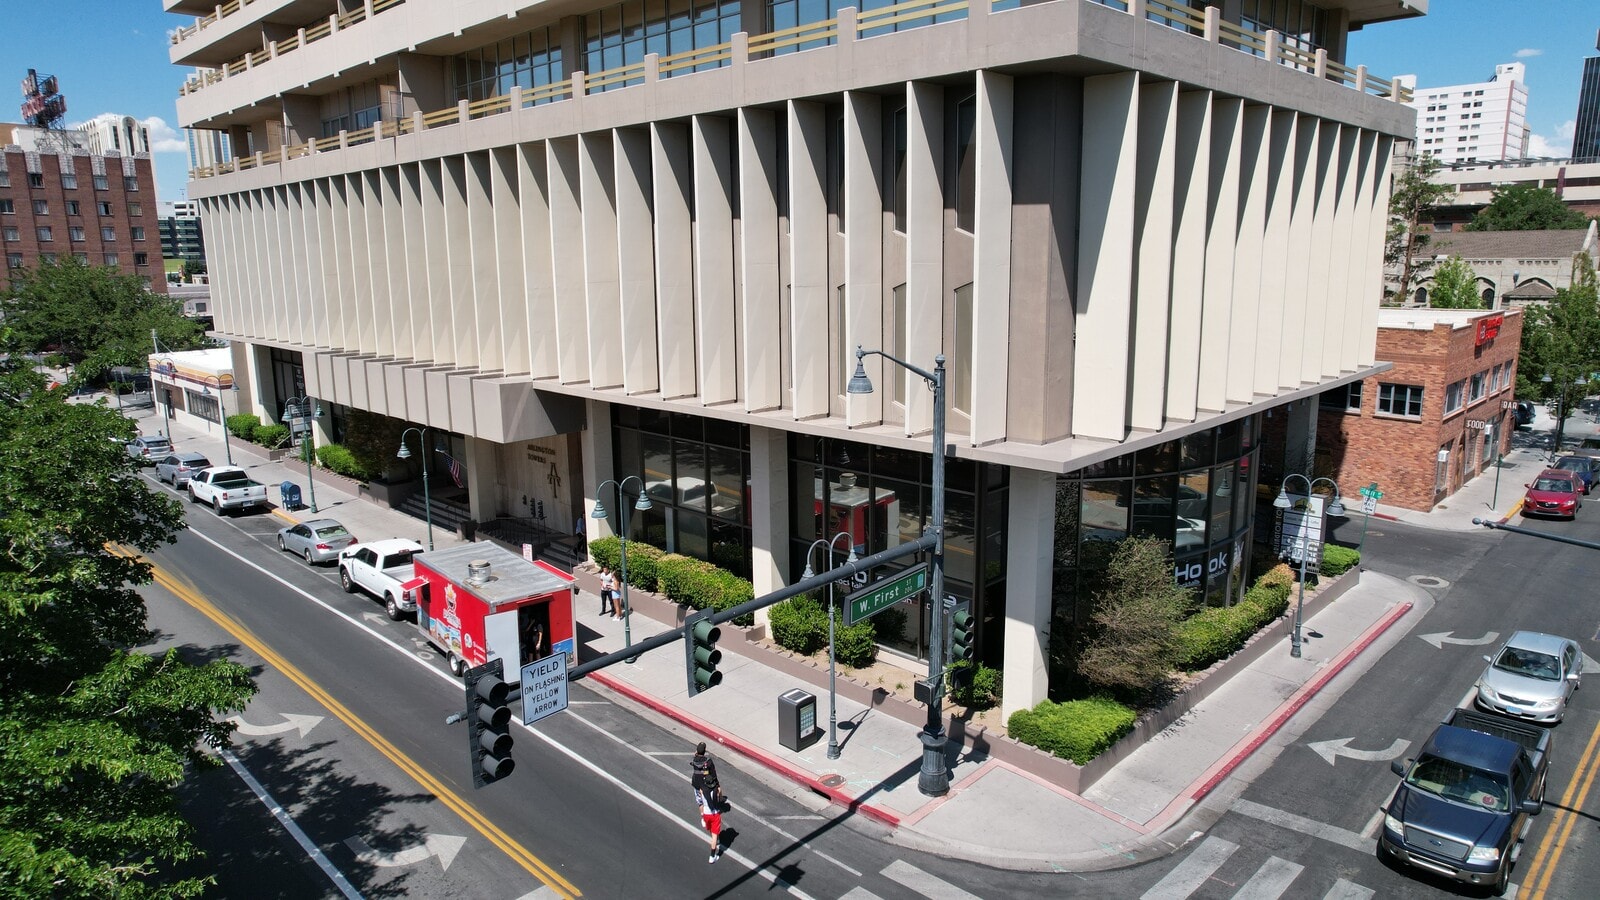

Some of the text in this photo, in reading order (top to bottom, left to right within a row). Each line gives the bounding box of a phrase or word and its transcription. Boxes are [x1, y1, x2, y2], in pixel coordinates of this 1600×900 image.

[1502, 401, 1517, 409] BAR
[1466, 420, 1485, 429] FOOD
[859, 600, 871, 614] W.
[874, 586, 900, 607] First
[529, 661, 559, 679] YIELD
[524, 673, 565, 695] ON FLASHING
[532, 686, 560, 704] YELLOW
[534, 698, 558, 716] ARROW
